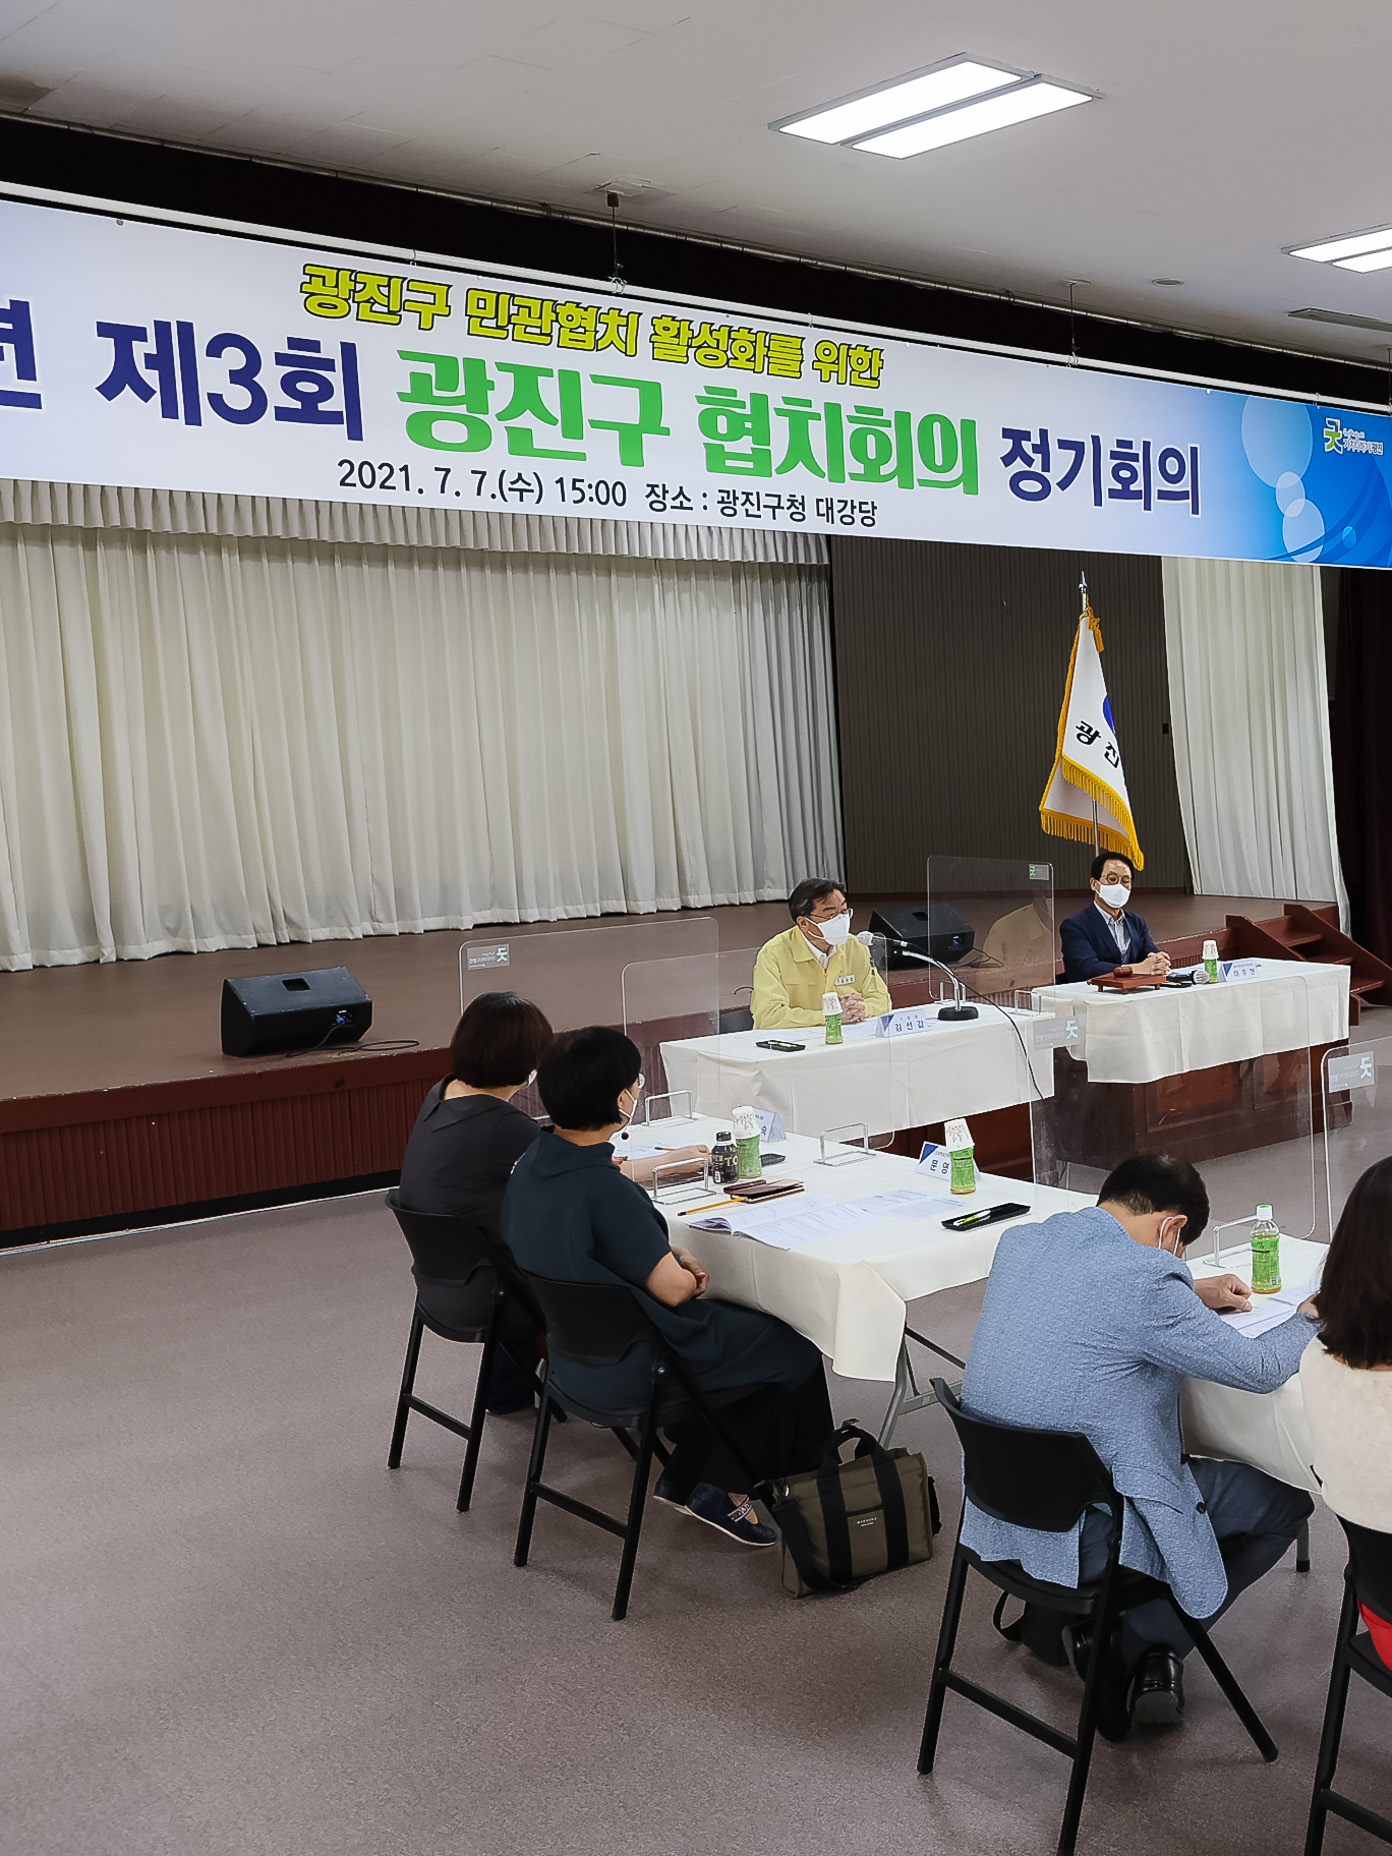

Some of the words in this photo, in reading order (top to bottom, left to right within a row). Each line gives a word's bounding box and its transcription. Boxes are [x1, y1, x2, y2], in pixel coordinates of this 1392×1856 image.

[300, 264, 451, 331] 광진구
[465, 288, 640, 358] 민관협치
[650, 315, 804, 380] 활성화를
[812, 340, 885, 390] 위한
[95, 319, 364, 442] 제3회
[396, 349, 671, 469] 광진구
[695, 384, 980, 497] 협치회의
[1000, 426, 1200, 516] 정기회의
[337, 458, 424, 496] 2021.
[433, 466, 462, 498] 7.
[554, 475, 628, 507] 15:00
[644, 483, 694, 512] 장소
[715, 488, 808, 525] 광진구청
[815, 494, 878, 529] 대강당
